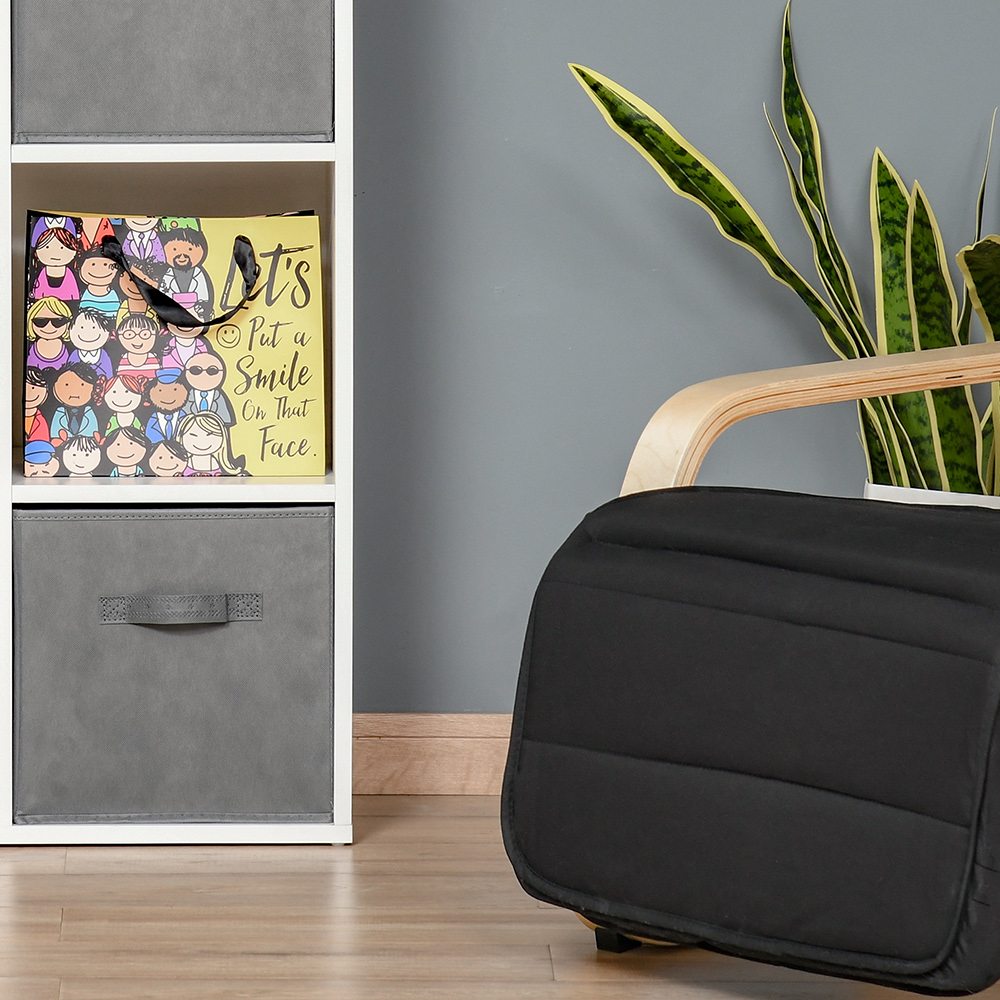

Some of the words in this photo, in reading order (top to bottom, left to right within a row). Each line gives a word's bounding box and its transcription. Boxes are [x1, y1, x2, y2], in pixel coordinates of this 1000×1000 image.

[248, 316, 293, 351] Put
[294, 331, 312, 347] a
[234, 350, 313, 395] Smile
[242, 399, 267, 421] On
[274, 396, 317, 420] That
